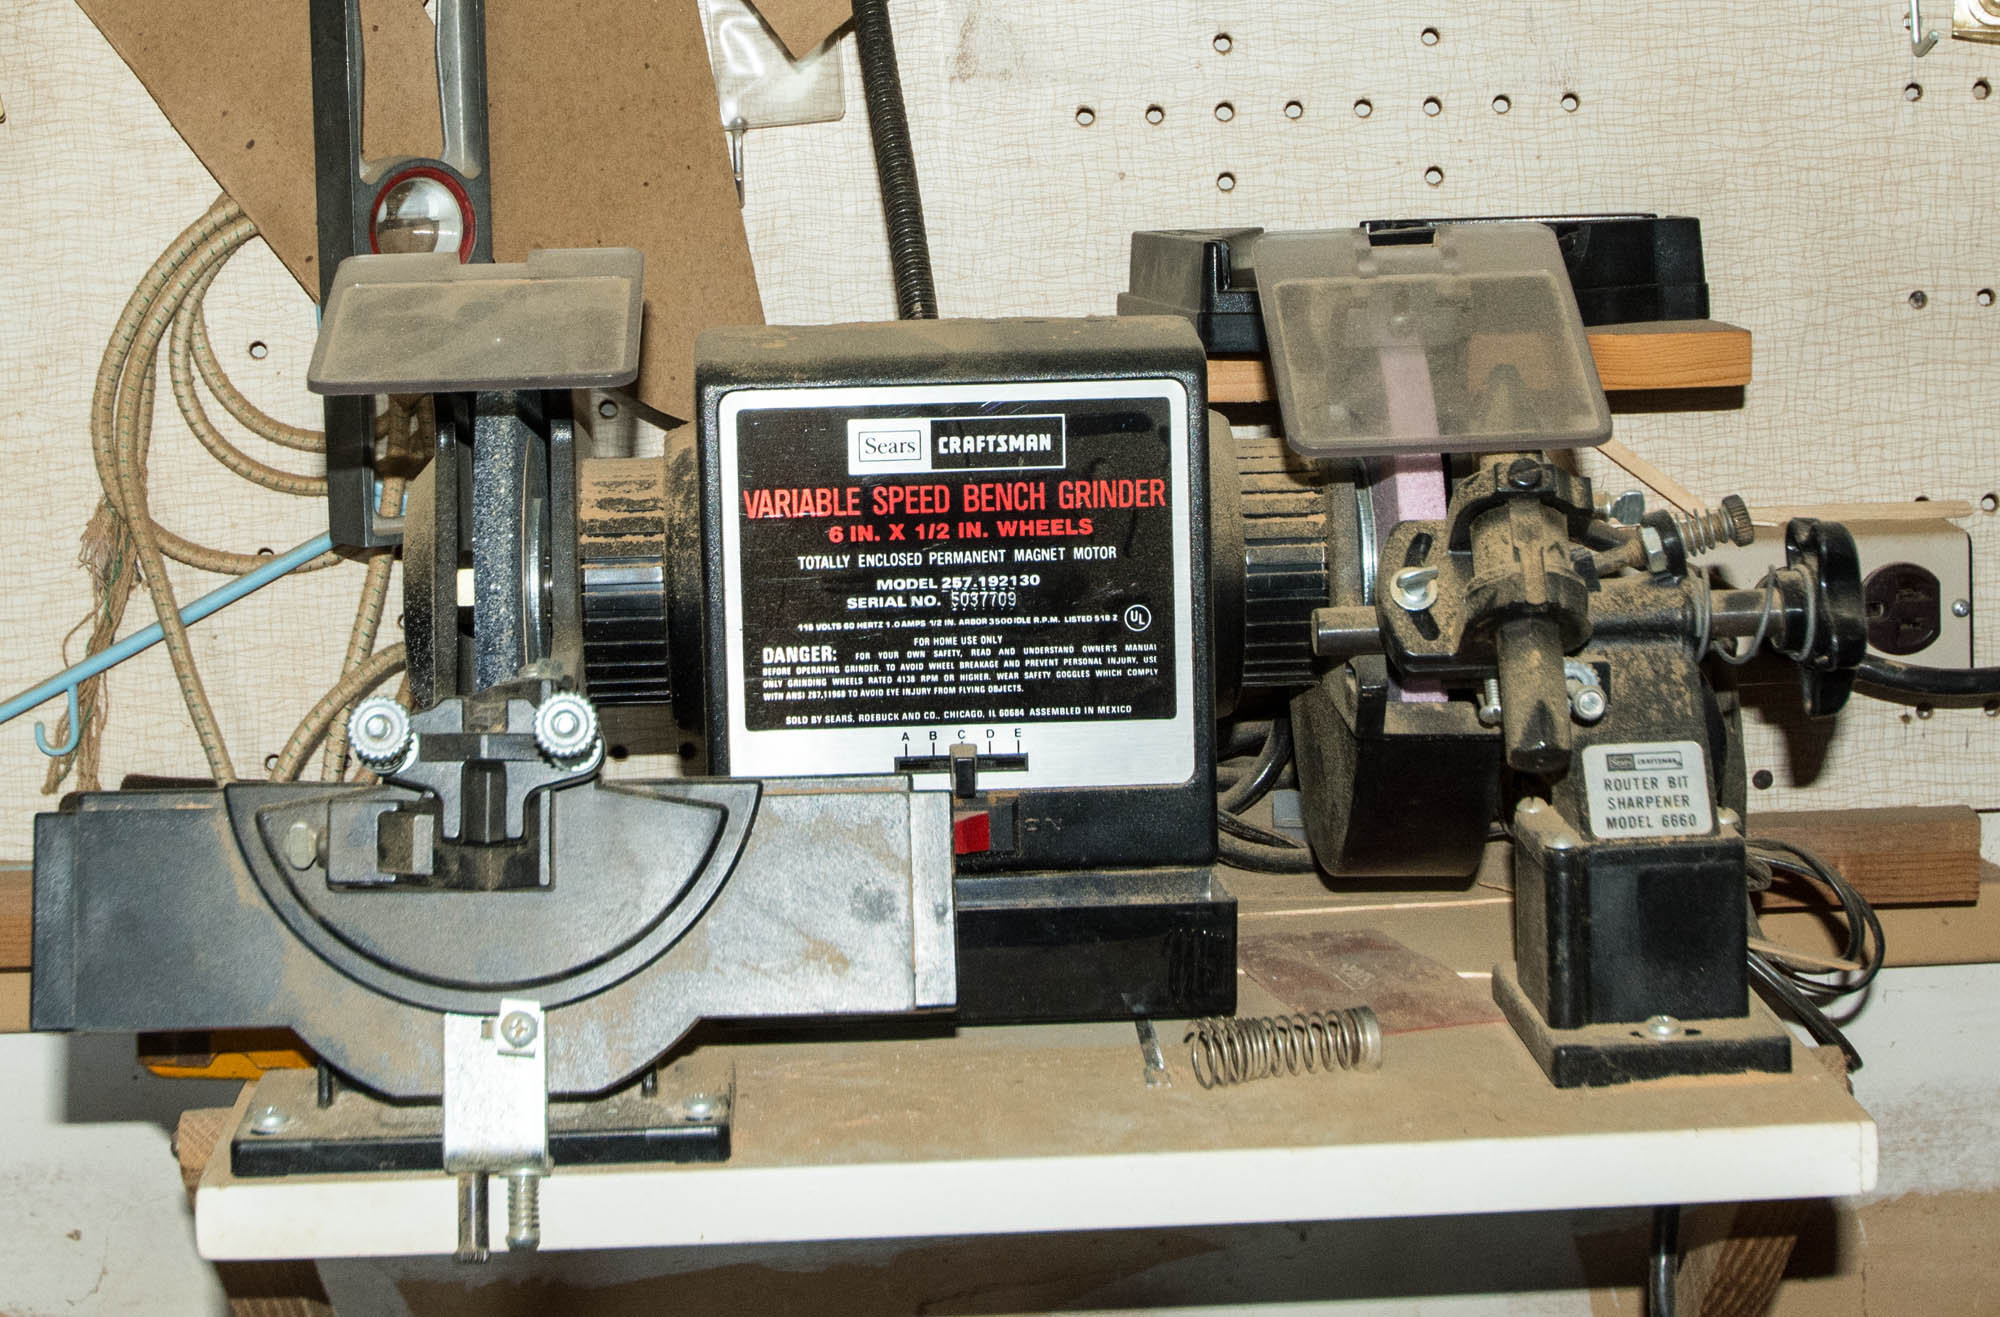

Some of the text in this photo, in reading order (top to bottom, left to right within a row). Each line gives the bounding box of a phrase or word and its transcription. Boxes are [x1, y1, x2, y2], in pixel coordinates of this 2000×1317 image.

[864, 437, 916, 455] Sears
[938, 433, 1052, 454] CRAFTSMAN
[743, 479, 1166, 519] VARIABLE SPEED BENCH GRINDER
[828, 518, 1094, 543] 6 IN. X 1/2 IN. WHEELS
[798, 546, 1117, 570] TOTALLY ENCLOSED PERMANENT MAGNET MOTOR
[876, 575, 1040, 591] MODEL 257.192130
[846, 592, 1017, 610] SERIAL NO. 5037709
[816, 622, 841, 632] VOLTS
[857, 621, 883, 630] HERTZ
[901, 620, 926, 628] AMPS
[929, 619, 942, 627] 1/2
[944, 619, 957, 627] IN.
[959, 617, 987, 626] ARBOR
[989, 617, 1013, 625] 3500
[1013, 616, 1031, 625] IDLE
[1033, 616, 1061, 624] R.P.M.
[1064, 615, 1093, 623] LISTED
[913, 635, 1003, 646] FOR HOME USE ONLY
[762, 646, 837, 664] DANGER:
[855, 652, 871, 661] FOR
[878, 651, 899, 660] YOUR
[906, 650, 925, 659] OWN
[933, 649, 963, 659] SAFETY,
[971, 649, 992, 657] READ
[998, 647, 1015, 656] AND
[1023, 646, 1075, 655] UNDERSTAND
[1082, 645, 1118, 653] OWNER'S
[762, 667, 791, 677] BEFORE
[796, 665, 840, 675] OPERATING
[886, 663, 896, 672] TO
[900, 663, 924, 671] AVOID
[928, 662, 955, 671] WHEEL
[959, 660, 999, 670] BREAKAGE
[1003, 659, 1021, 668] AND
[1025, 658, 1059, 667] PREVENT
[1063, 657, 1102, 666] PERSONAL
[1143, 655, 1157, 664] USE
[762, 679, 783, 689] ONLY
[787, 678, 827, 688] GRINDING
[832, 677, 864, 686] WHEELS
[868, 676, 893, 684] RATED
[920, 674, 939, 682] RPM
[943, 674, 955, 682] OR
[959, 673, 991, 681] HIGHER.
[996, 671, 1019, 680] WEAR
[1024, 671, 1051, 680] SAFETY
[1056, 670, 1090, 678] GOGGLES
[1095, 669, 1122, 677] WHICH
[1127, 668, 1159, 677] COMPLY
[762, 692, 784, 701] WITH
[848, 689, 858, 698] TO
[860, 689, 884, 697] AVOID
[886, 688, 900, 696] EYE
[902, 687, 931, 696] INJURY
[934, 686, 956, 695] FROM
[958, 685, 985, 694] FLYING
[987, 684, 1024, 694] OBJECTS.
[785, 715, 809, 725] SOLD
[810, 715, 823, 724] BY
[858, 712, 900, 722] ROEBUCK
[902, 711, 921, 721] AND
[989, 709, 997, 718] IL
[999, 708, 1025, 717] 60684
[1029, 706, 1081, 716] ASSEMBLED
[1084, 706, 1094, 715] IN
[1097, 705, 1132, 714] MEXICO
[901, 728, 1022, 741] A B C D E
[1604, 775, 1689, 792] ROUTER BIT
[1607, 794, 1690, 810] SHARPENER
[1606, 813, 1697, 830] MODEL 6660
